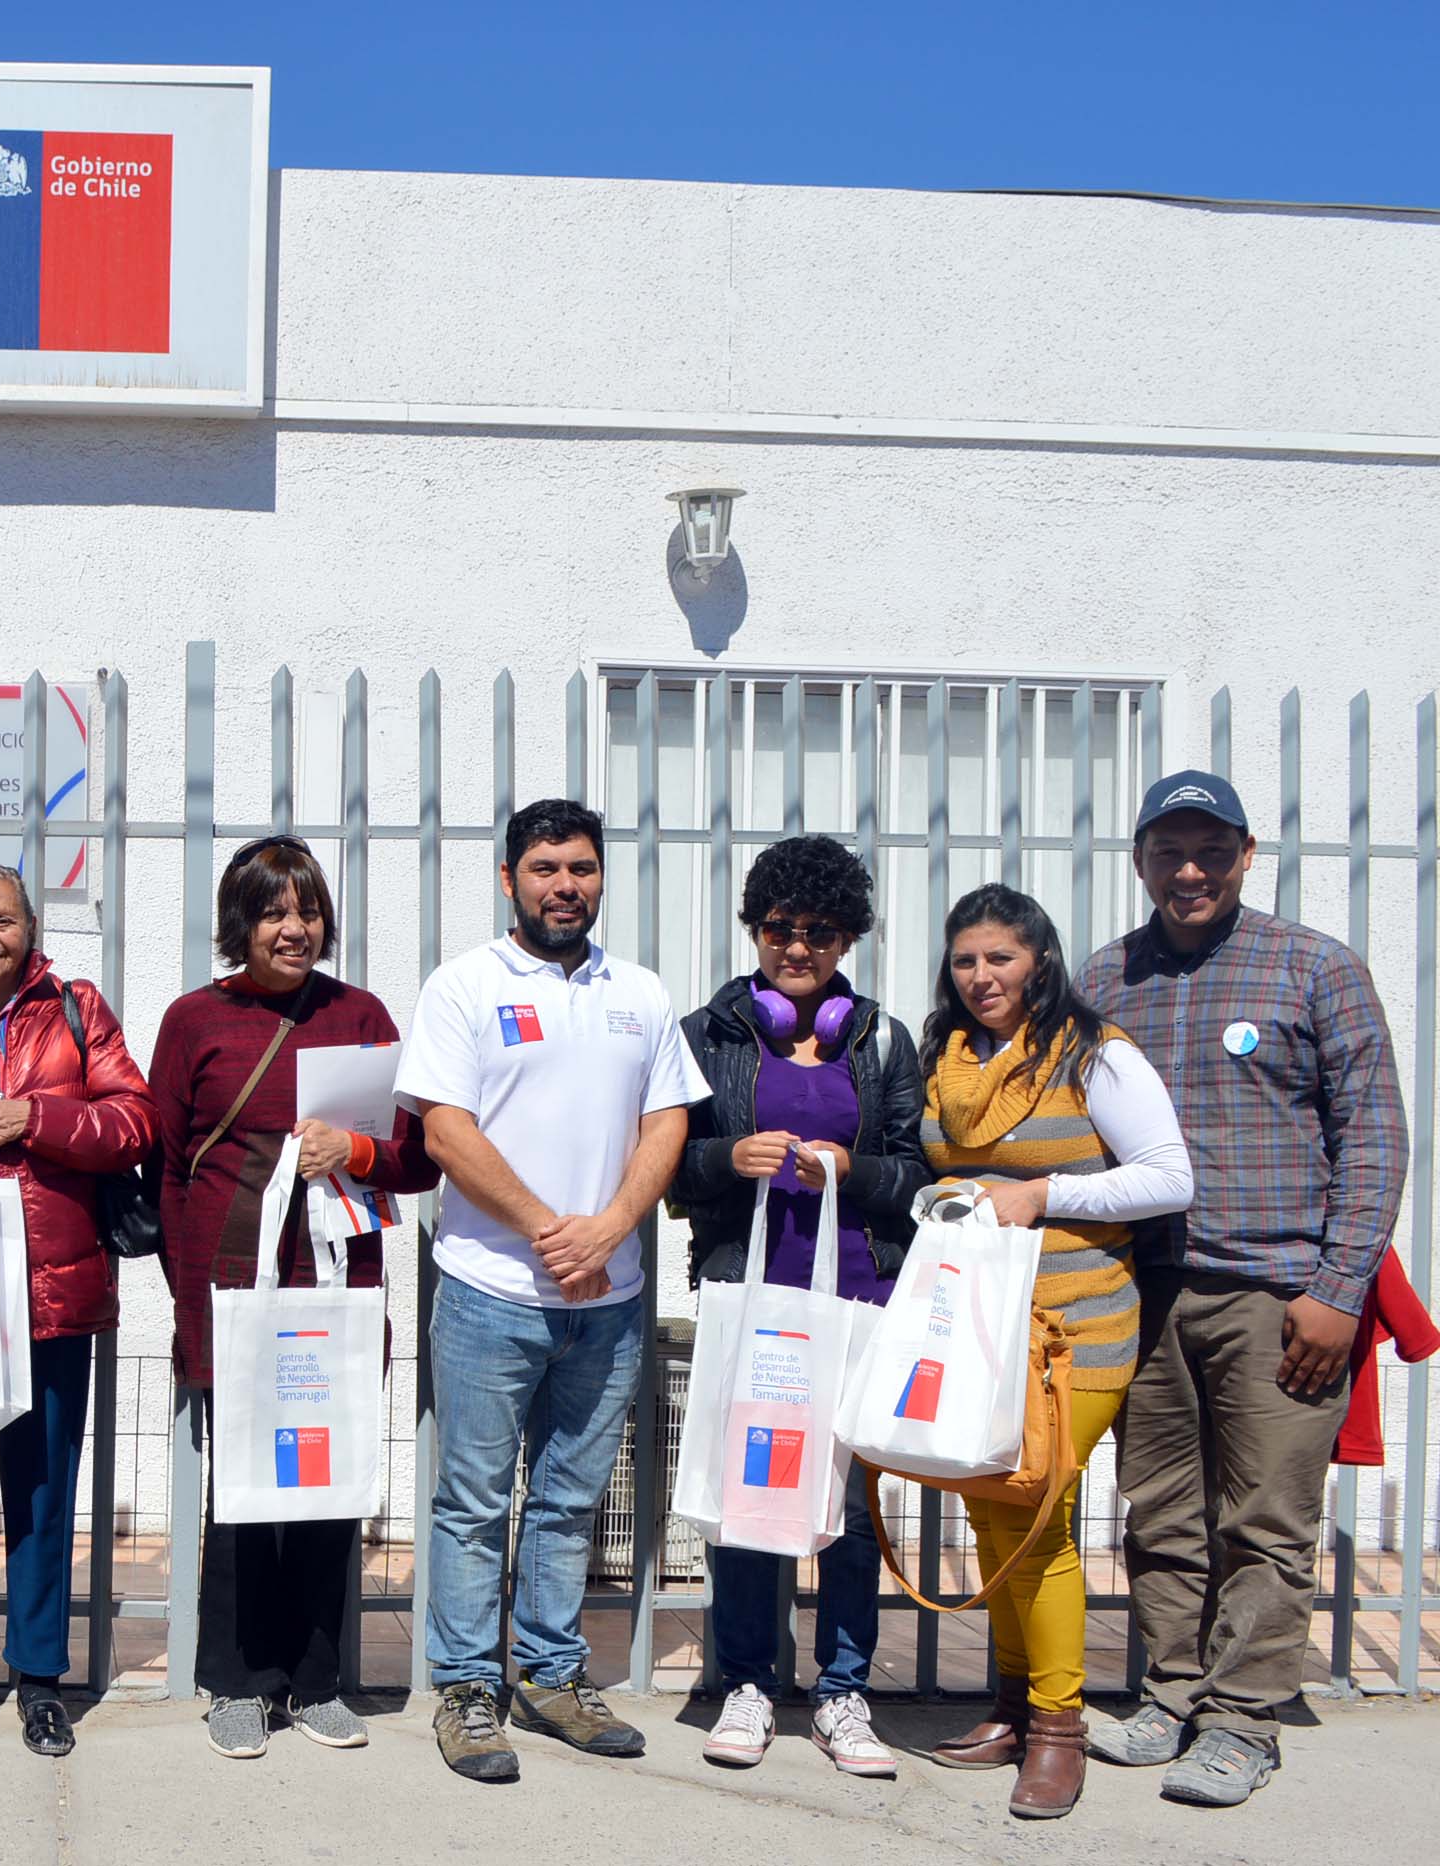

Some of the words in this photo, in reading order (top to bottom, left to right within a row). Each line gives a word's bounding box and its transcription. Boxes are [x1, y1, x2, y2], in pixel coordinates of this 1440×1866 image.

[50, 155, 153, 177] Gobierno
[50, 177, 77, 196] de
[83, 178, 142, 198] Chile
[276, 1353, 303, 1363] Centro
[305, 1352, 317, 1362] de
[753, 1350, 784, 1362] Centro
[787, 1353, 799, 1363] de
[276, 1363, 320, 1374] Desarrollo
[752, 1361, 801, 1374] Desarrollo
[275, 1374, 286, 1384] de
[287, 1373, 330, 1385] Negocios
[752, 1371, 764, 1382] de
[765, 1372, 810, 1386] Negocios
[276, 1390, 330, 1403] Tamarugal
[751, 1387, 810, 1405] Tamarugal
